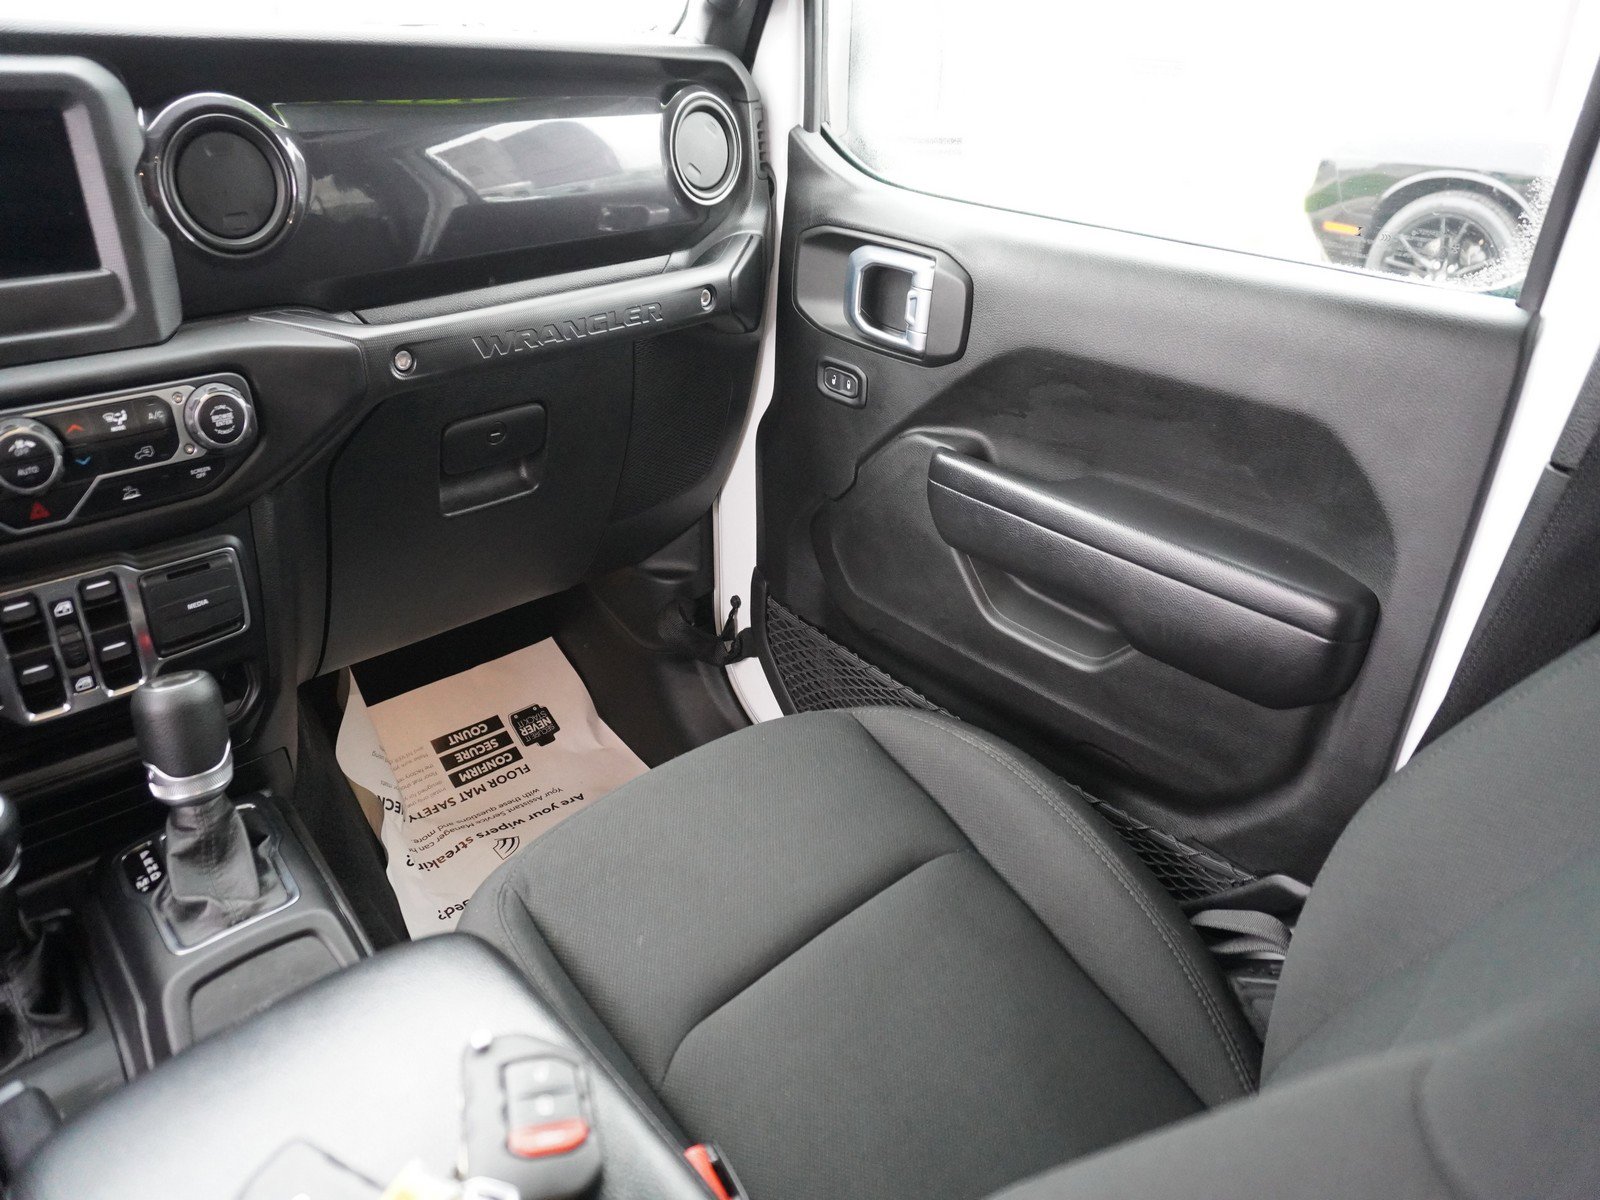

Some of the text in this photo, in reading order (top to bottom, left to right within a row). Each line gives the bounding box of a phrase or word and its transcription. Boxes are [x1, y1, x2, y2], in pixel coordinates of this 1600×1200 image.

[471, 301, 664, 359] WRANGLER
[148, 410, 165, 420] A/C
[17, 465, 40, 476] AUTO
[187, 599, 210, 610] MEDIA
[523, 710, 548, 726] STACK
[447, 723, 489, 746] COUNT
[520, 717, 552, 737] NEVER
[531, 725, 556, 740] SECURE
[454, 738, 499, 763] SECURE
[458, 752, 513, 782] CONFIRM
[486, 763, 531, 788] FLOOR
[459, 783, 488, 803] MAT
[522, 788, 540, 799] with
[545, 787, 564, 798] Your
[560, 793, 585, 806] Are
[408, 796, 457, 823] SAFETY
[499, 796, 522, 809] these
[508, 794, 543, 813] Assistant
[456, 806, 497, 823] questions
[476, 810, 507, 823] Service
[528, 802, 560, 821] your
[436, 822, 475, 843] Manager
[437, 821, 454, 832] and
[475, 818, 526, 839] wipers
[418, 841, 435, 851] can
